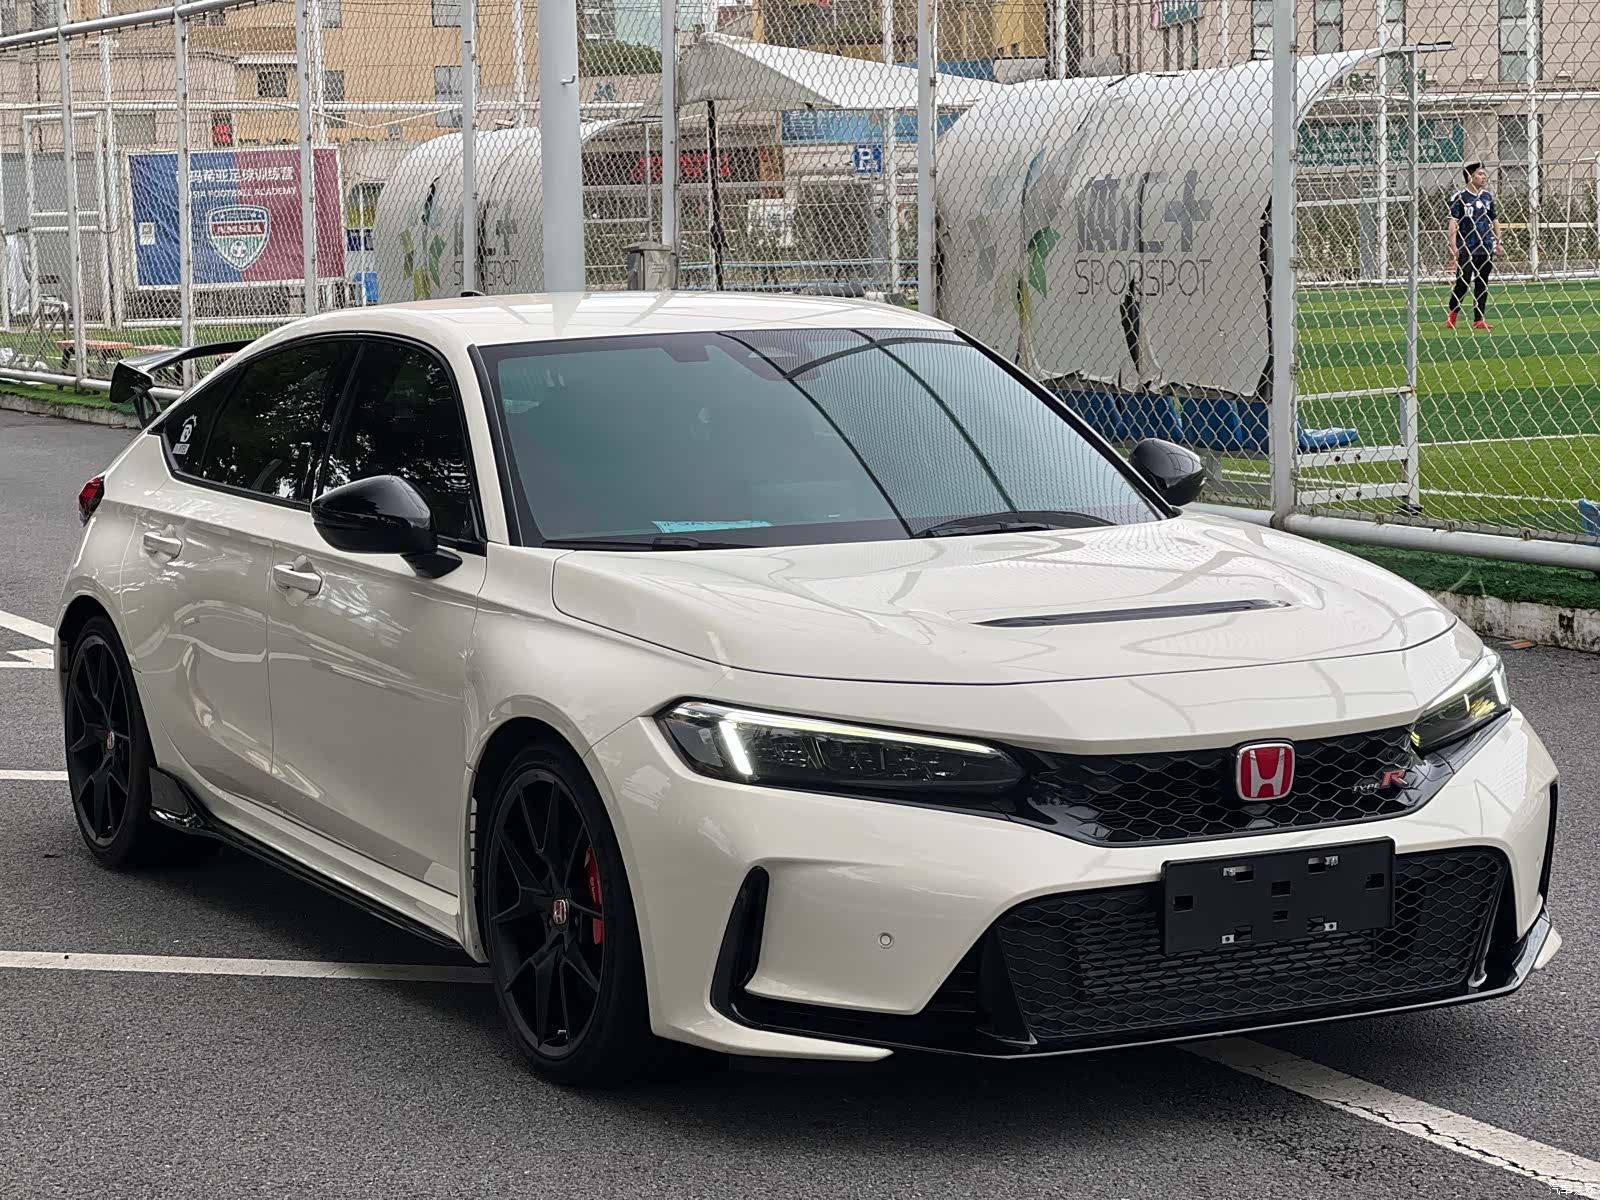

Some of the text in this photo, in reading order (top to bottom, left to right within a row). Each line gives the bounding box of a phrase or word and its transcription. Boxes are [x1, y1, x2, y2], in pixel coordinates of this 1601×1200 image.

[176, 167, 294, 183] 玛希亚足球训练营
[254, 186, 297, 197] ACADEMY
[217, 223, 262, 233] AMSIA
[1352, 767, 1408, 793] TYPE R
